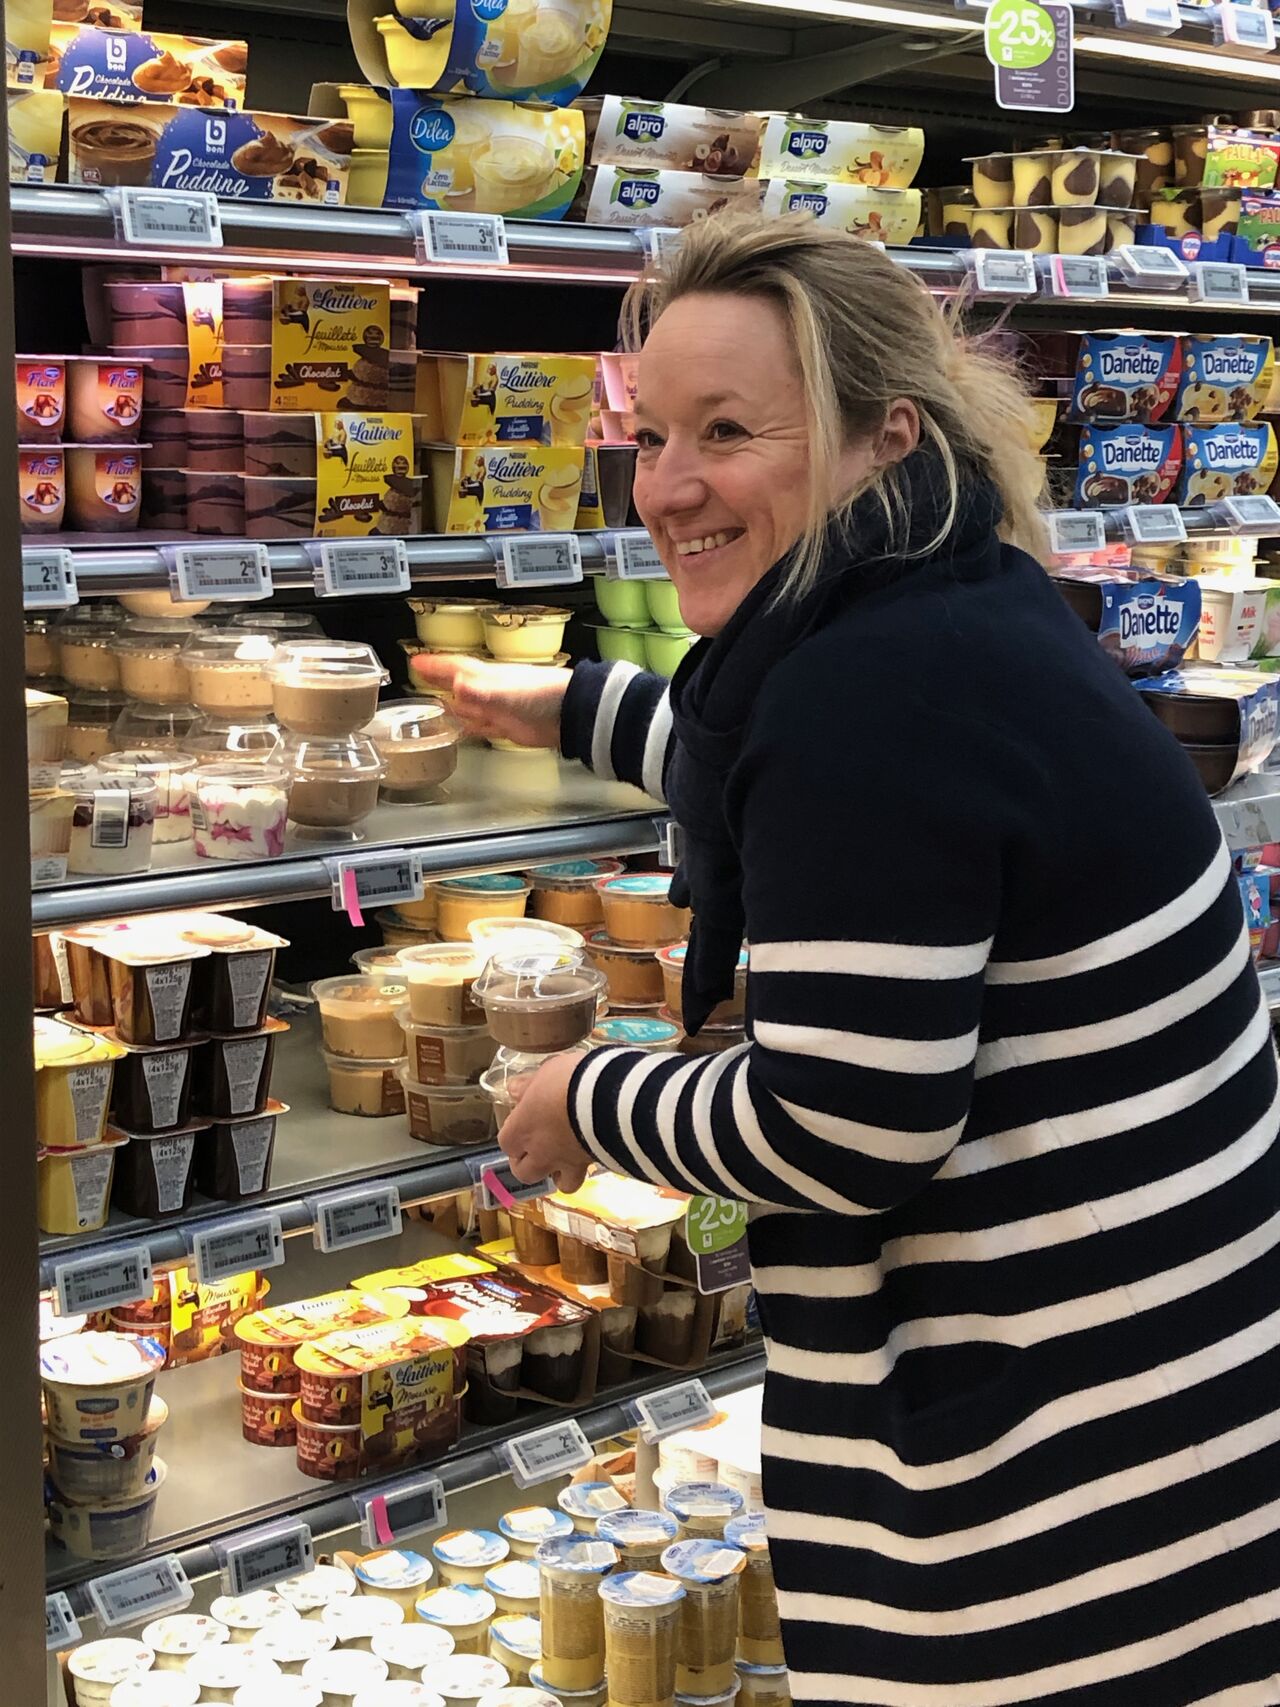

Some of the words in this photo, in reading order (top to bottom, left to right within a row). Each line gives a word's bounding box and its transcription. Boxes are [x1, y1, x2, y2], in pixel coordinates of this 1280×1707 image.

[990, 9, 1054, 48] -25%
[1056, 9, 1069, 62] DEALS
[1056, 65, 1069, 105] DUO
[412, 118, 453, 142] Dilea
[627, 115, 662, 136] alpro
[206, 144, 225, 154] boni
[791, 133, 825, 152] alpro
[83, 169, 98, 179] UTZ
[161, 148, 250, 197] Pudding
[433, 171, 449, 181] Zero
[621, 182, 657, 203] alpro
[790, 194, 825, 212] alpro
[312, 289, 378, 312] Laitière
[300, 365, 341, 379] Chocolat
[1101, 353, 1160, 376] Danette
[1203, 353, 1256, 375] Danette
[28, 372, 56, 388] Flan
[108, 372, 136, 388] Flan
[499, 365, 558, 392] Laitière
[505, 395, 544, 414] Pudding
[350, 422, 403, 444] Laitière
[1104, 441, 1161, 465] Danette
[1205, 441, 1258, 462] Danette
[28, 460, 57, 476] Flan
[106, 460, 134, 476] Flan
[487, 456, 545, 482] Laitière
[492, 486, 532, 502] Pudding
[340, 498, 374, 511] Chocolat
[380, 556, 388, 571] 3
[555, 549, 563, 564] 2
[41, 566, 51, 583] 2
[240, 560, 249, 577] 2
[1120, 604, 1180, 640] Danette
[376, 1204, 381, 1219] 1
[256, 1234, 262, 1250] 1
[123, 1266, 129, 1282] 1
[204, 1287, 241, 1303] Mousse
[395, 1361, 449, 1386] Laitière
[395, 1386, 438, 1404] Mousse
